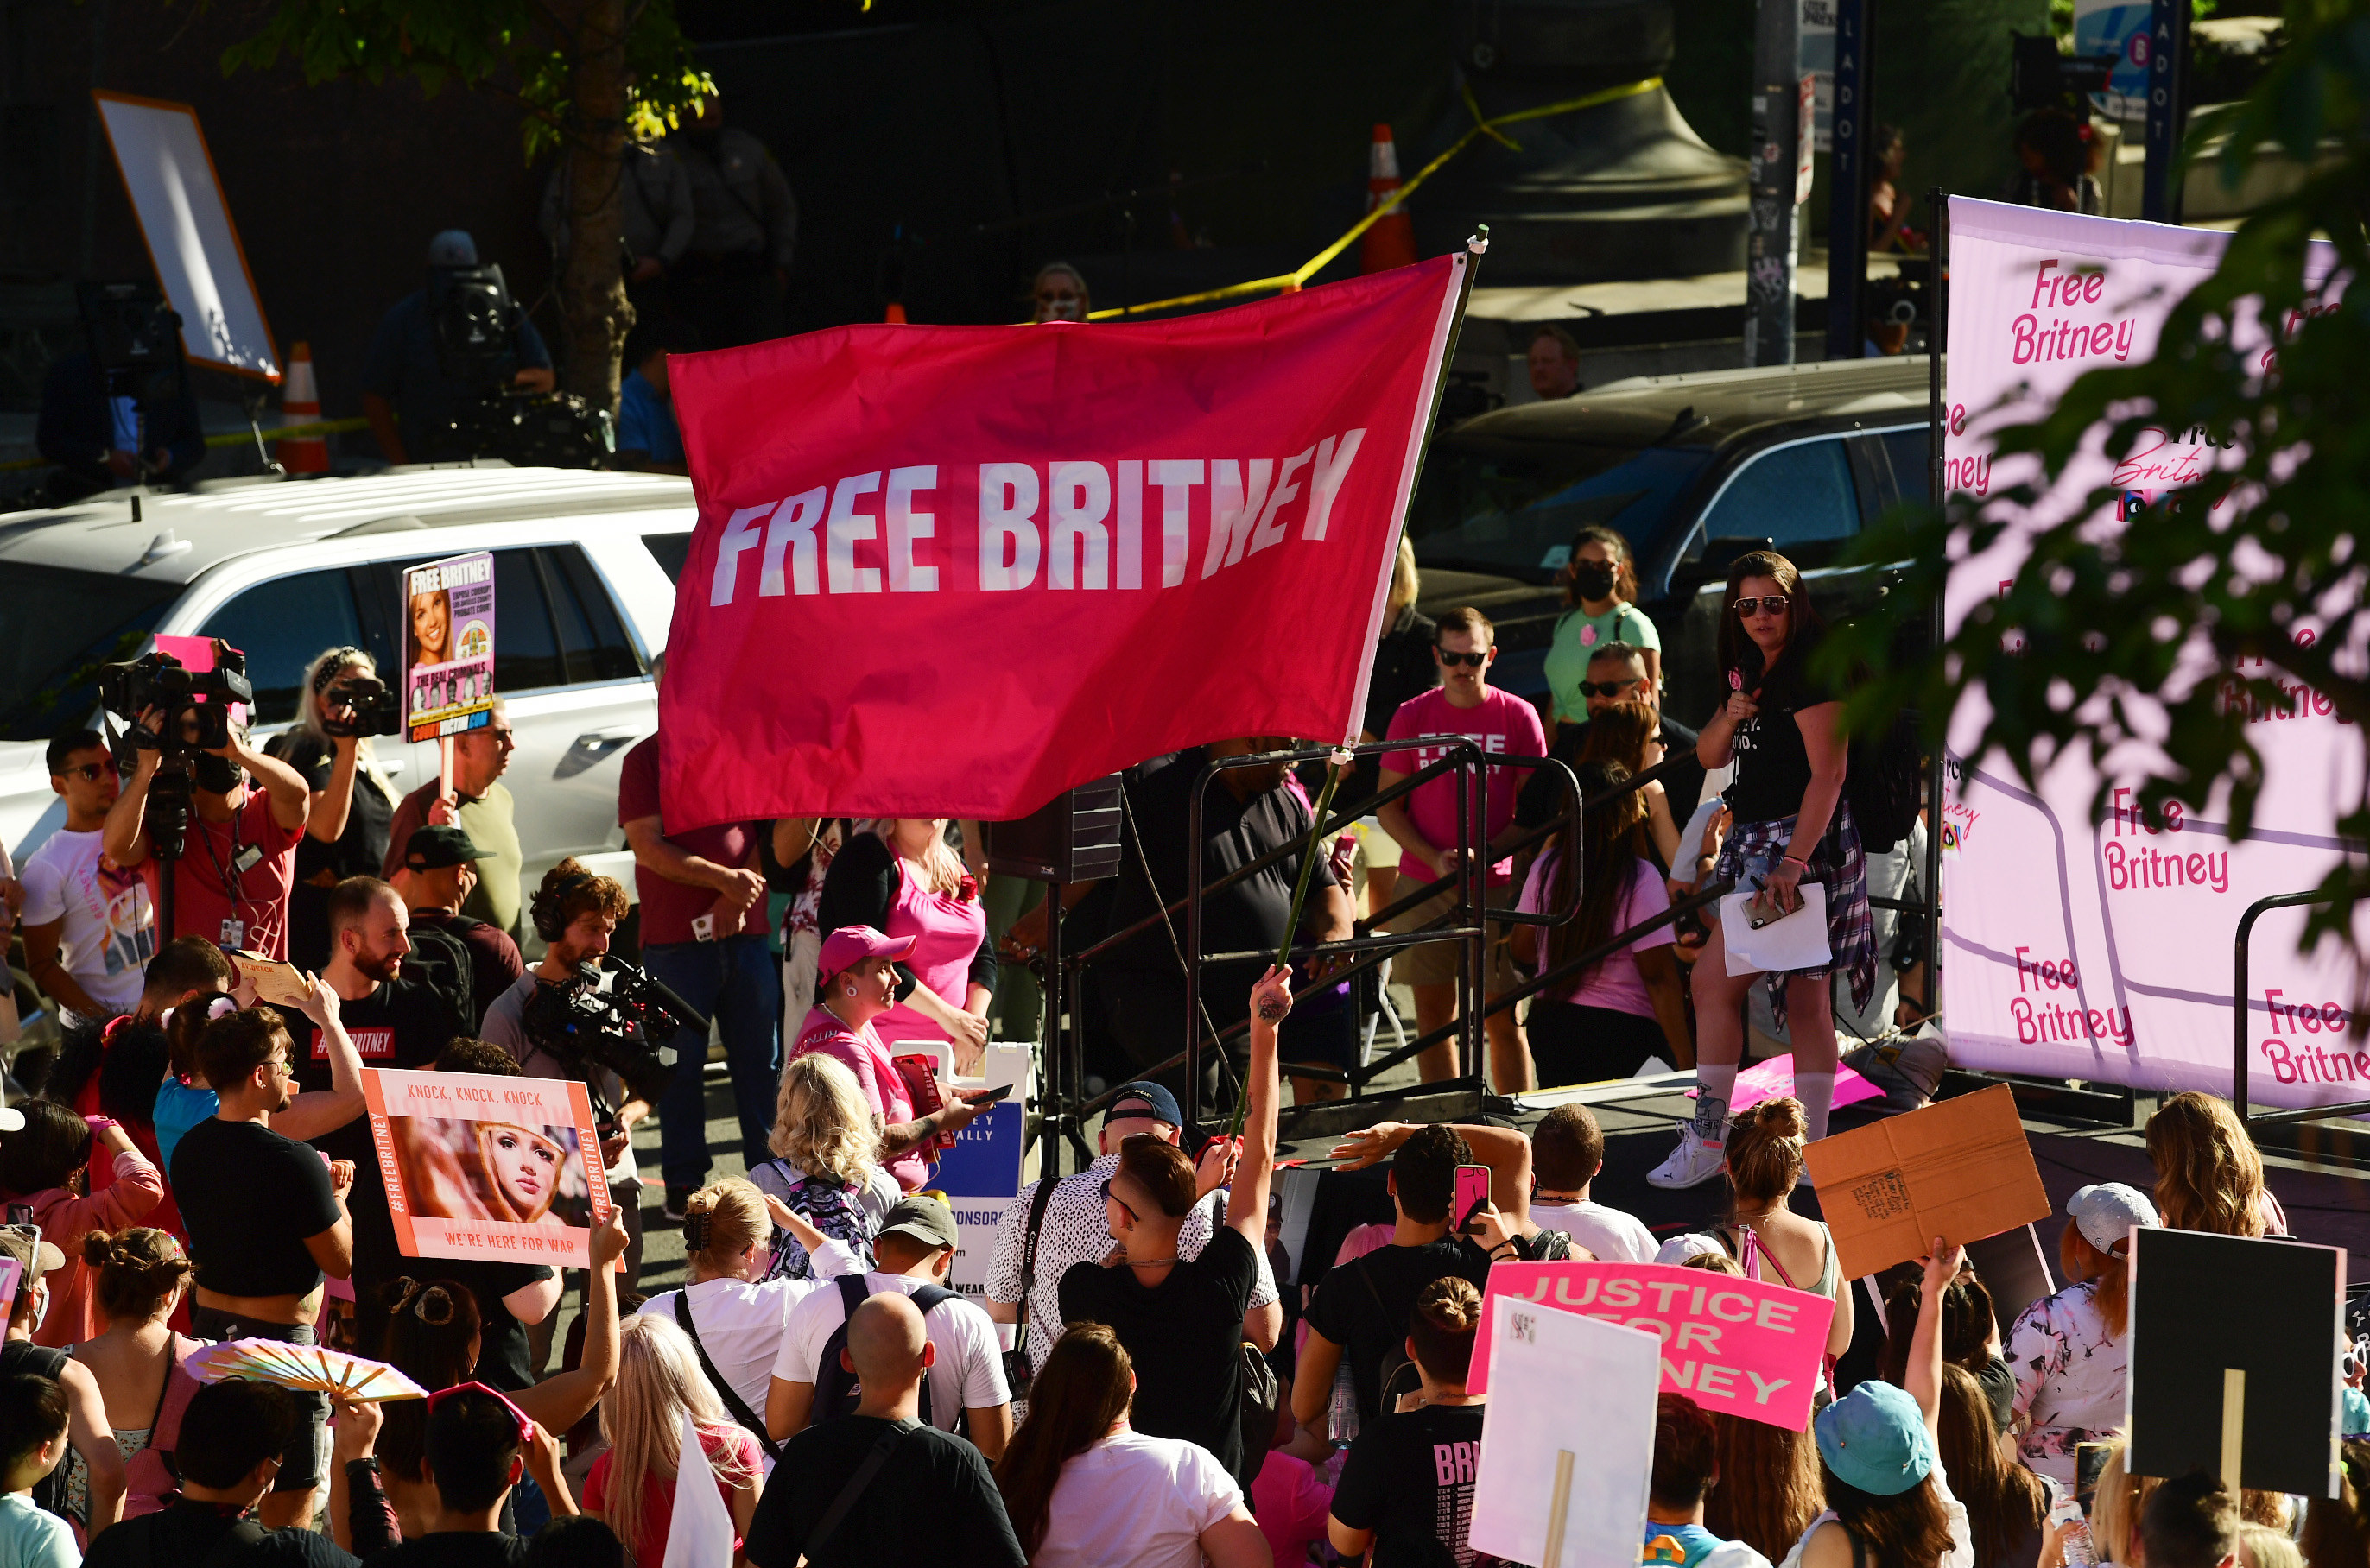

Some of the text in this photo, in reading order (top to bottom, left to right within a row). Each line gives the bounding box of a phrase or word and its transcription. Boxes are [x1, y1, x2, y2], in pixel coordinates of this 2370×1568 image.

[2031, 259, 2105, 309] Free
[2012, 314, 2136, 364] Britney
[711, 428, 1366, 607] FREE BRITNEY
[410, 557, 491, 597] FREE BRITNEY
[2105, 841, 2229, 893] Britney
[241, 962, 275, 973] EVIDENCE
[2015, 946, 2078, 992] Free
[2010, 997, 2135, 1046] Britney
[2265, 989, 2346, 1034] Free
[2260, 1039, 2370, 1084] Britne
[407, 1084, 542, 1107] KNOCK, KNOCK, KNOCK
[371, 1112, 405, 1213] #FREEBRITNEY
[445, 1231, 575, 1254] WE'RE HERE FOR WAR
[1026, 1230, 1036, 1263] Canon
[1514, 1276, 1799, 1334] JUSTICE
